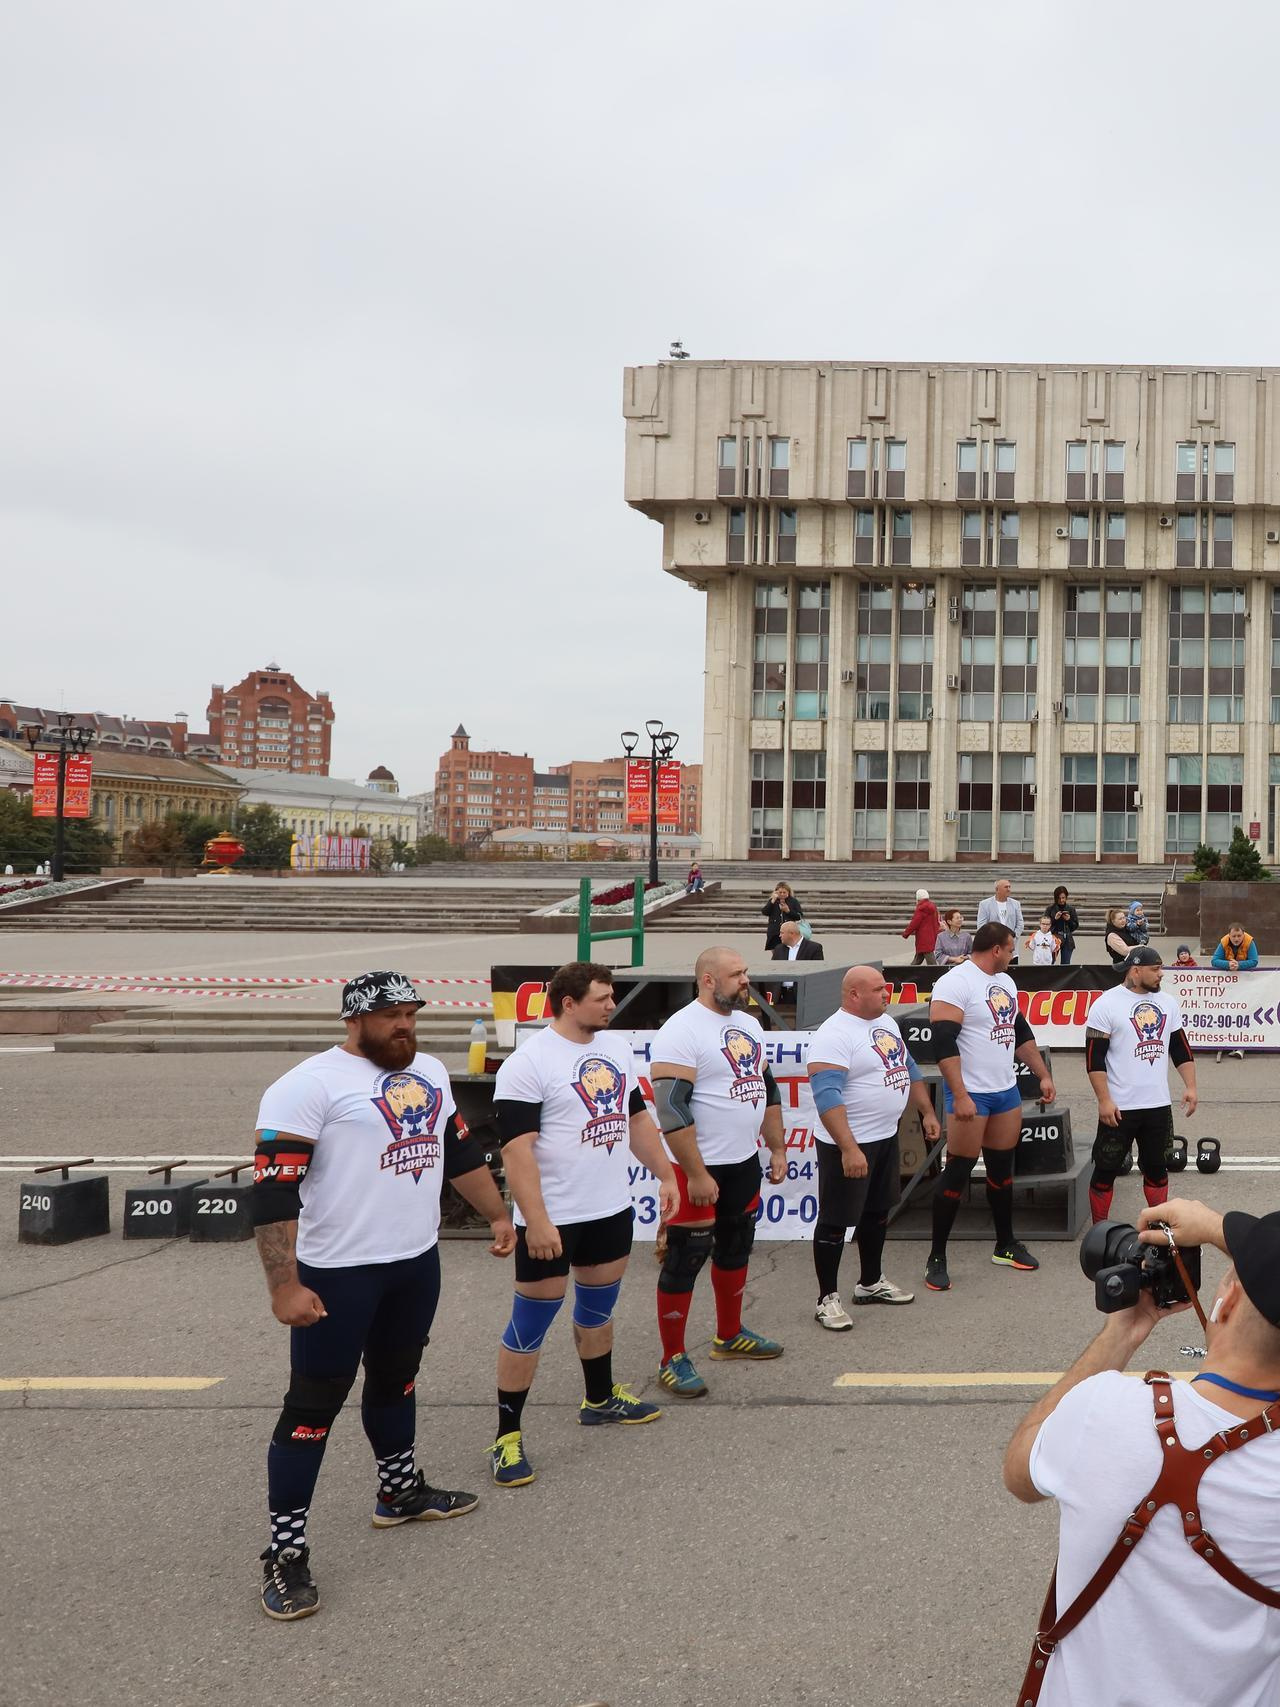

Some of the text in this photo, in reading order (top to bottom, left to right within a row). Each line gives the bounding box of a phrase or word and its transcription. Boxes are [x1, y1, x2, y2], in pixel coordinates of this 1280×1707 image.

[1173, 974, 1239, 985] 300 метров
[1180, 986, 1226, 997] от ТГПУ
[1204, 1000, 1247, 1009] Толстого
[1012, 1062, 1035, 1076] 22
[594, 1132, 622, 1147] МИРА
[1021, 1125, 1059, 1142] 240
[382, 1142, 440, 1168] НАЦИЯ
[1201, 1152, 1210, 1161] 24
[253, 1165, 308, 1180] OWER
[396, 1157, 434, 1175] МИРА
[22, 1195, 50, 1211] 240
[131, 1199, 172, 1216] 200
[197, 1198, 238, 1214] 220
[291, 1431, 327, 1440] POWER
